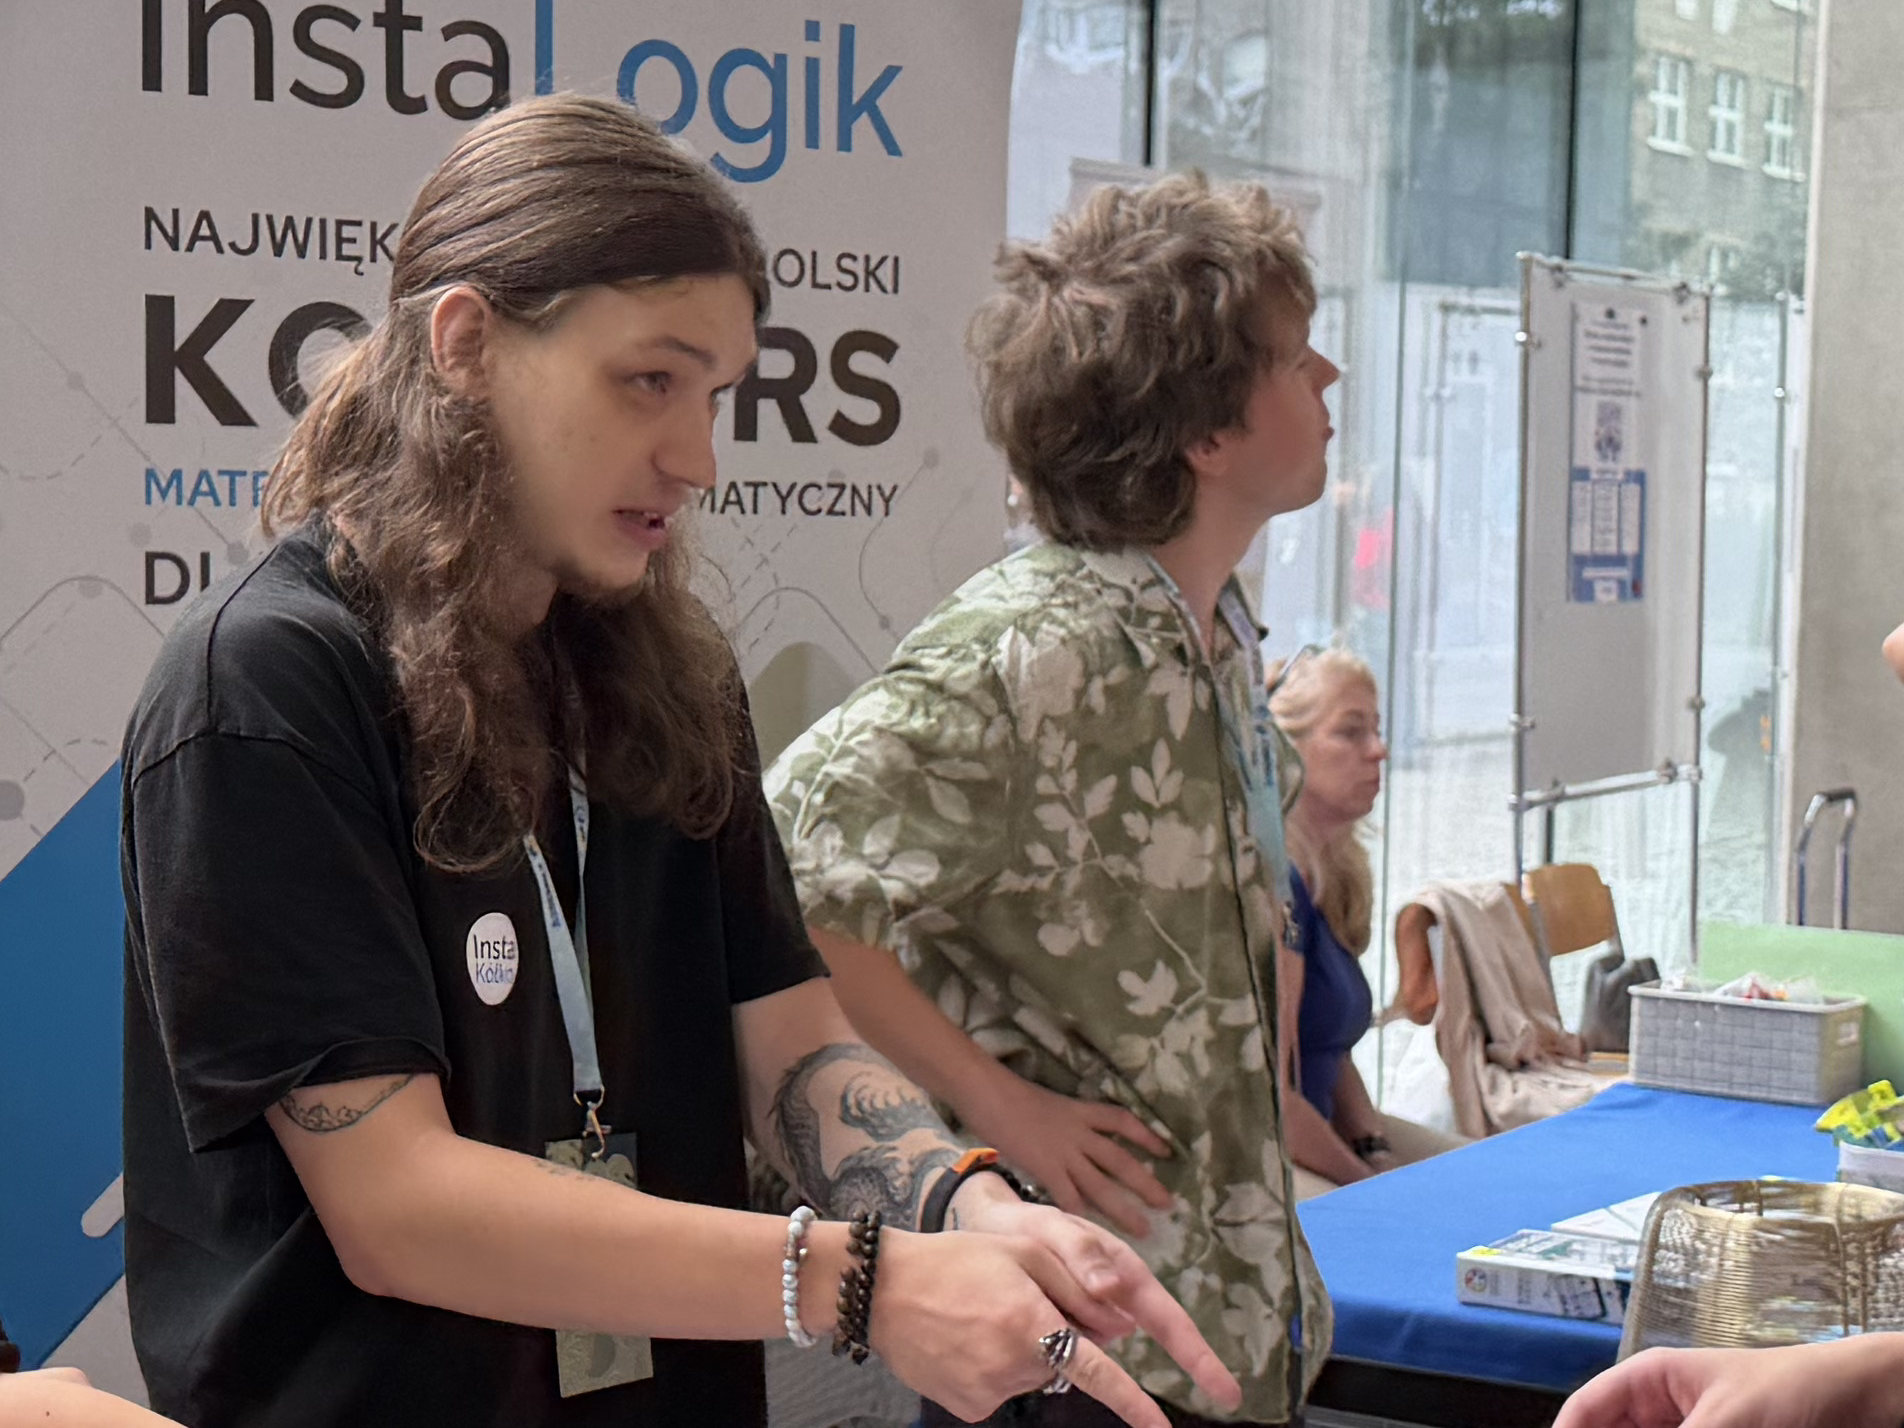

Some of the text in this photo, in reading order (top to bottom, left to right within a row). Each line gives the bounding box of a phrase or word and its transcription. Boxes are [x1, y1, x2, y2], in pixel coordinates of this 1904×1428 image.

[143, 207, 398, 275] NAJWIĘK
[772, 247, 900, 294] OLSKI
[473, 933, 516, 960] Insta
